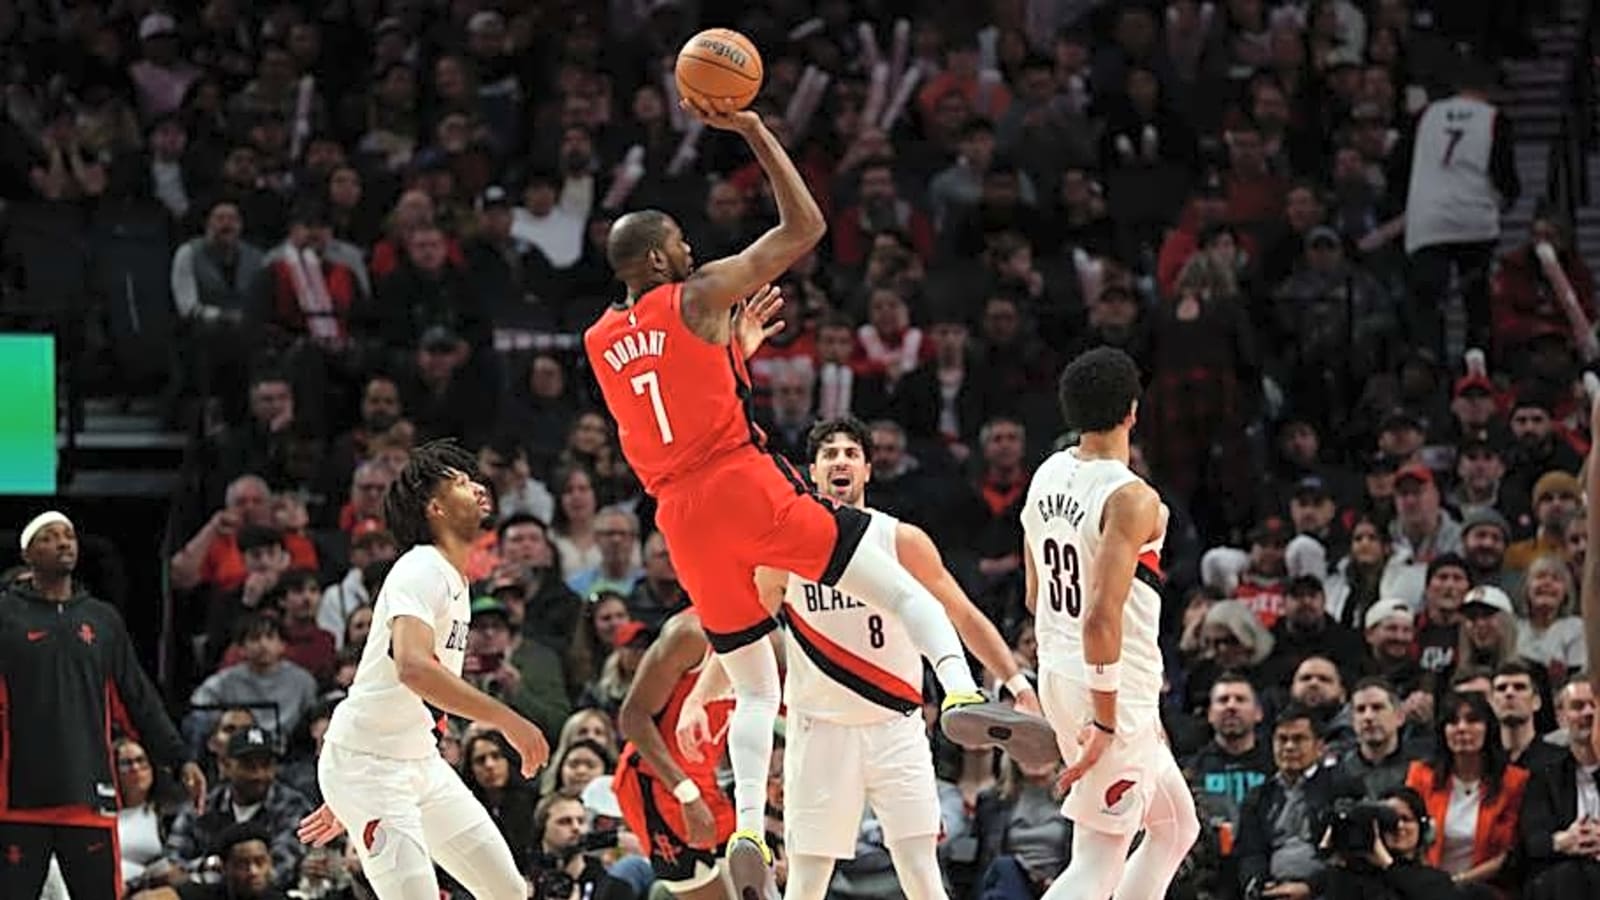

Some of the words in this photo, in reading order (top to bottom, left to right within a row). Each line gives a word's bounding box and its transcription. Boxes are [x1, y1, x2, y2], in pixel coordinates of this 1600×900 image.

[1443, 127, 1465, 166] 7
[603, 329, 667, 372] DURANT
[630, 370, 674, 445] 7
[1043, 537, 1082, 618] 33
[868, 614, 884, 649] 8
